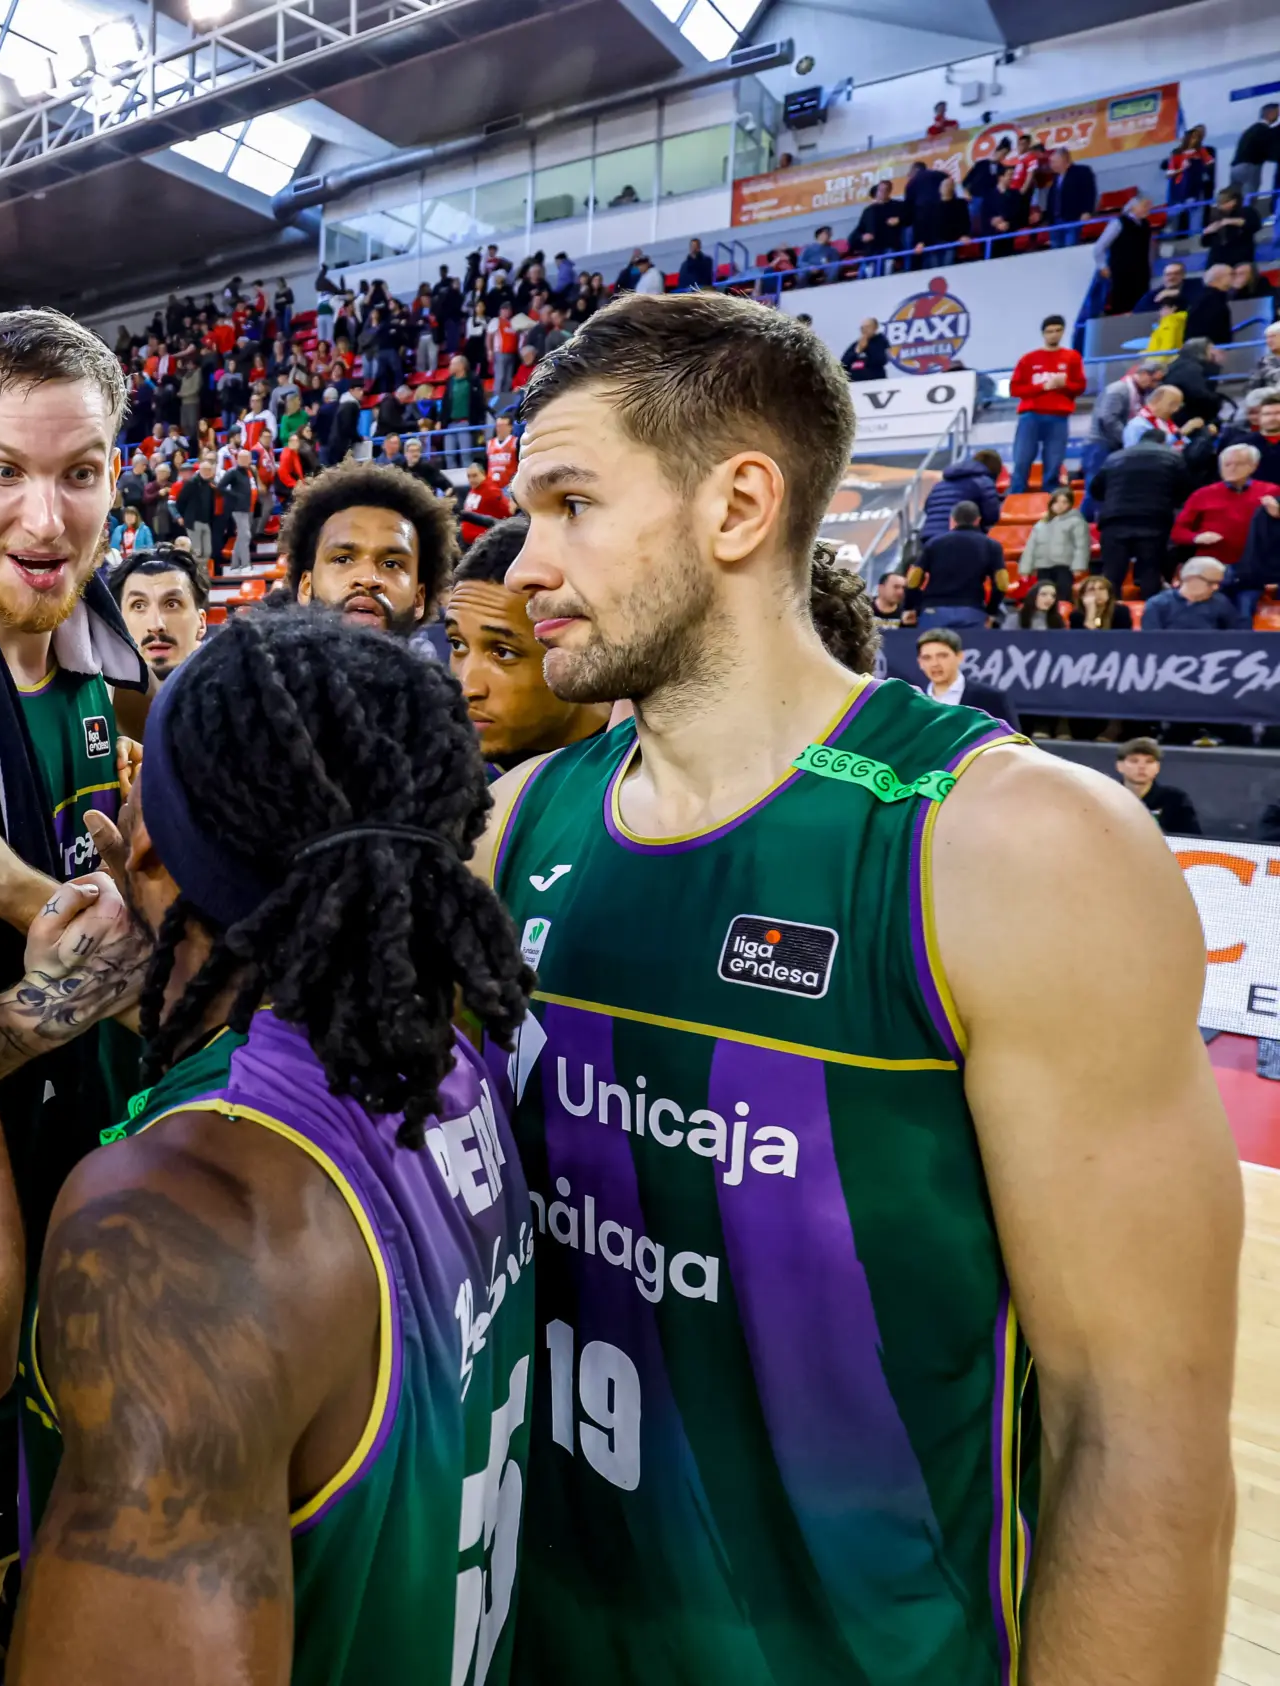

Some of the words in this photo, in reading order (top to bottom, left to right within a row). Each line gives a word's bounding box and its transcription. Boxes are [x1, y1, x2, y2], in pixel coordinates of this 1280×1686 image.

[887, 312, 969, 346] BAXI
[733, 934, 775, 960] liga
[728, 955, 821, 988] endesa
[556, 1056, 800, 1187] Unicaja
[545, 1317, 642, 1492] 19
